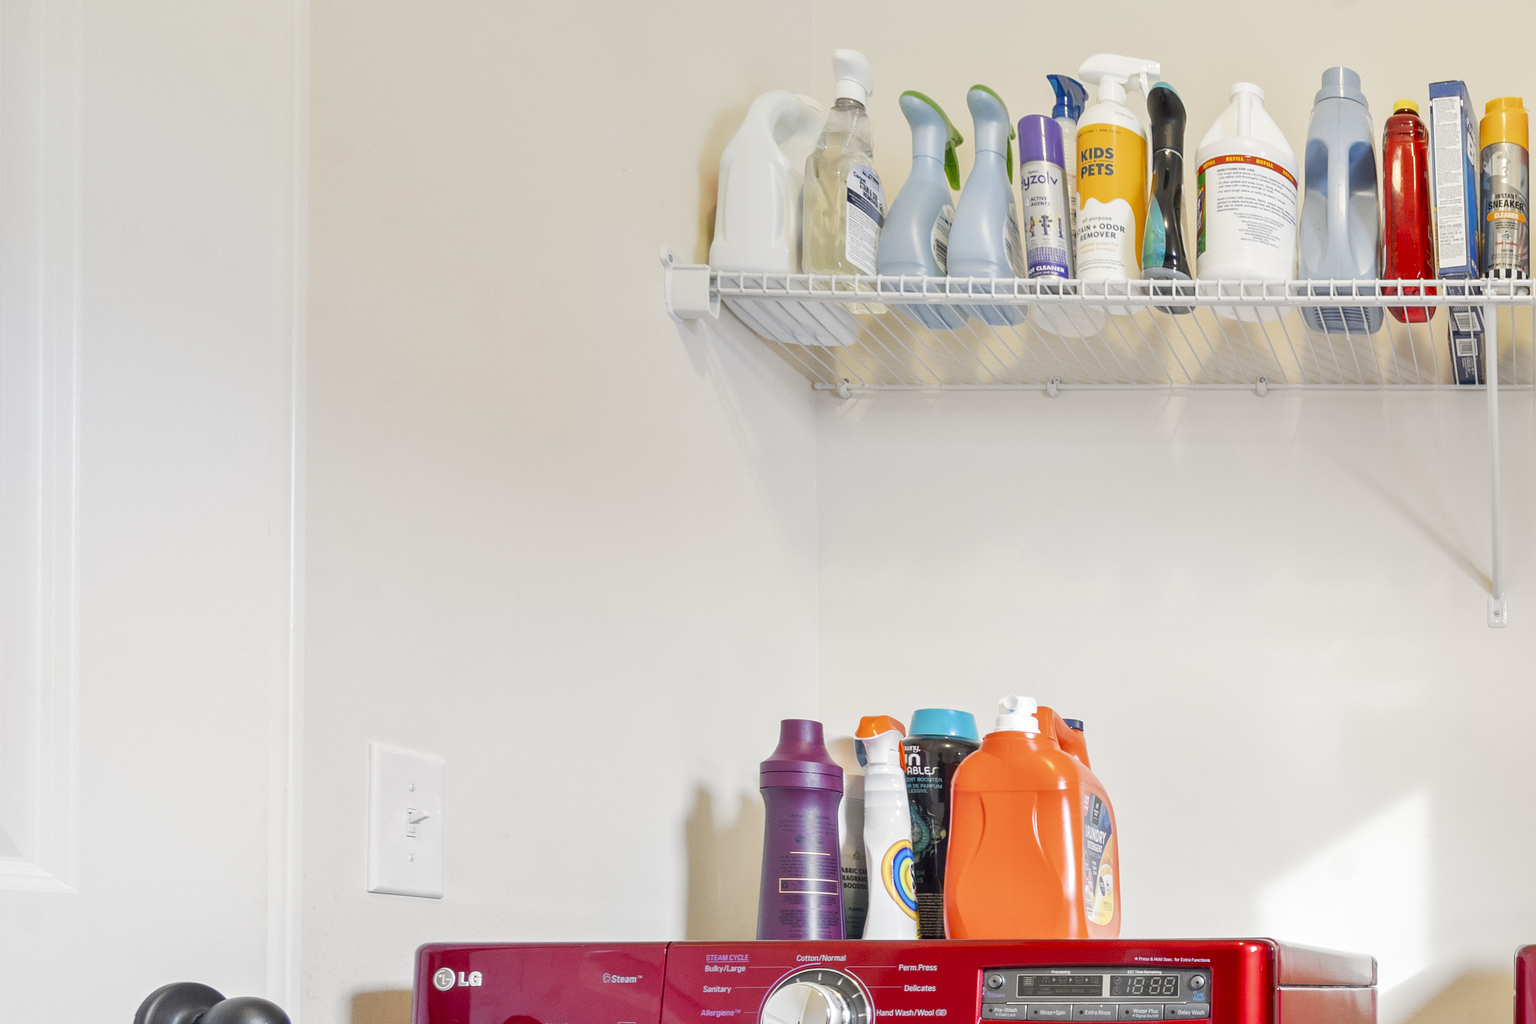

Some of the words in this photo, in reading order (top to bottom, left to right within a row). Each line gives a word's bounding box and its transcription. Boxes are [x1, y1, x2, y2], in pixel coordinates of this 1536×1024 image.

[1081, 147, 1114, 162] KIDS
[1256, 159, 1274, 168] REFILL
[1081, 163, 1114, 179] PETS
[1488, 200, 1524, 211] SNEAKER
[1494, 212, 1519, 220] CLEANER
[1099, 223, 1125, 233] ODOR
[1080, 231, 1116, 242] REMOVER
[1035, 265, 1065, 274] CLEANER
[841, 867, 858, 875] ABRIC
[796, 954, 847, 962] Cotton/Normal
[704, 965, 746, 973] Bulky/Large
[458, 971, 483, 987] LG
[703, 986, 732, 994] Sanitary
[894, 1009, 934, 1017] Wash/Wool
